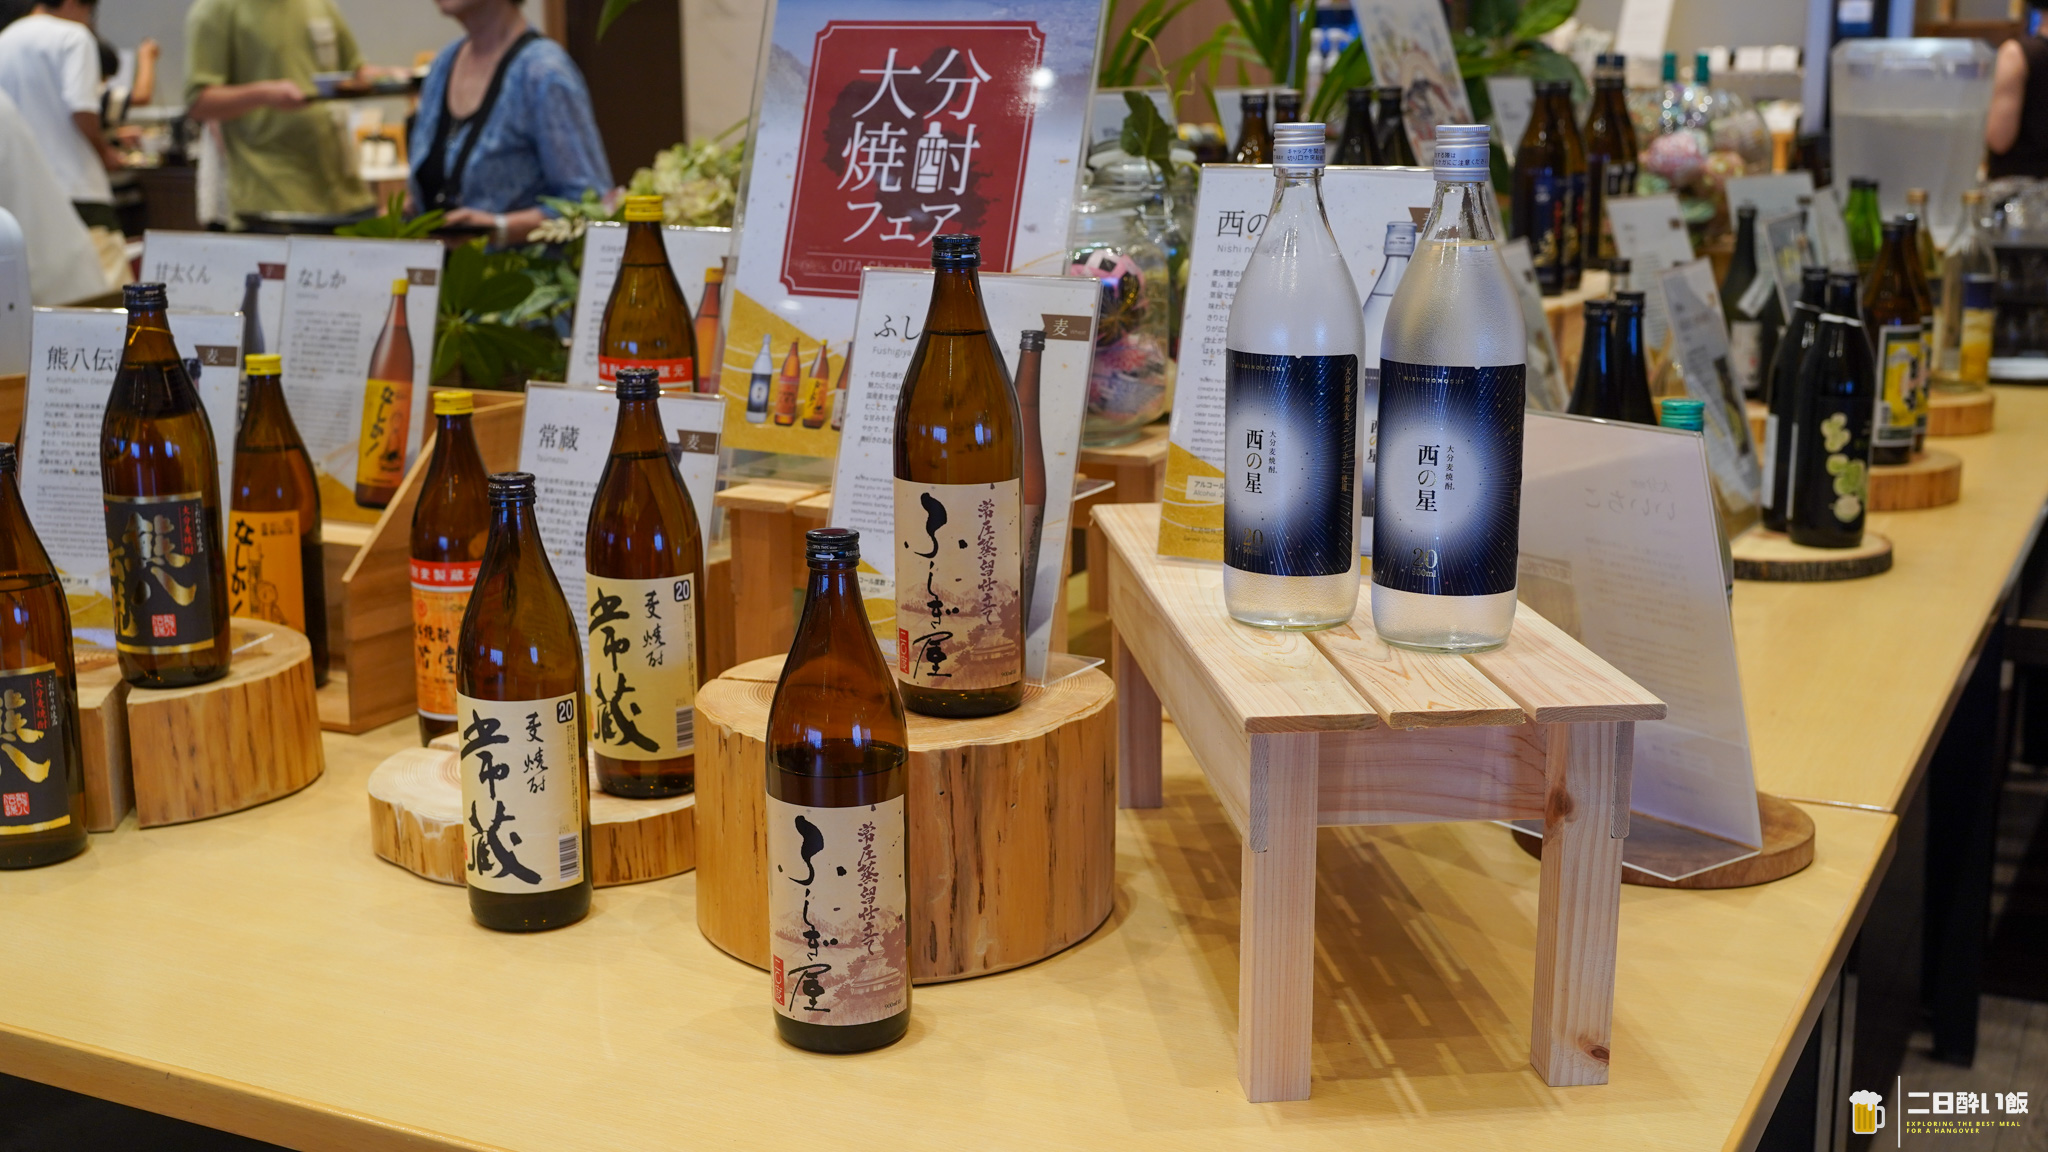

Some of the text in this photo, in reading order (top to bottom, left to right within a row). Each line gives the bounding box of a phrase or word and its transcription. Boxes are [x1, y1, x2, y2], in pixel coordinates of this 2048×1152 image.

[851, 48, 992, 120] 大分
[836, 121, 981, 196] 焼酎
[843, 201, 962, 247] フェア
[298, 268, 346, 289] なしか
[831, 257, 864, 274] OITA
[206, 348, 219, 364] 麦
[1052, 318, 1069, 337] 麦
[539, 424, 580, 451] 常蔵
[687, 434, 701, 451] 麦
[1245, 429, 1264, 494] 西の星
[1415, 444, 1440, 513] 西の星
[903, 492, 968, 679] ふしぎ屋
[977, 499, 998, 625] 常圧蒸留仕立て
[1413, 548, 1437, 568] 20
[674, 582, 691, 601] 20
[643, 590, 667, 668] 麦焼酎
[589, 587, 661, 752] 常蔵
[34, 678, 47, 730] 大分麦焼酎
[558, 699, 574, 722] 20
[523, 711, 548, 794] 麦焼酎
[460, 708, 542, 885] 常蔵
[778, 815, 848, 1013] ふしぎ屋
[857, 821, 880, 955] 常圧蒸留仕立て
